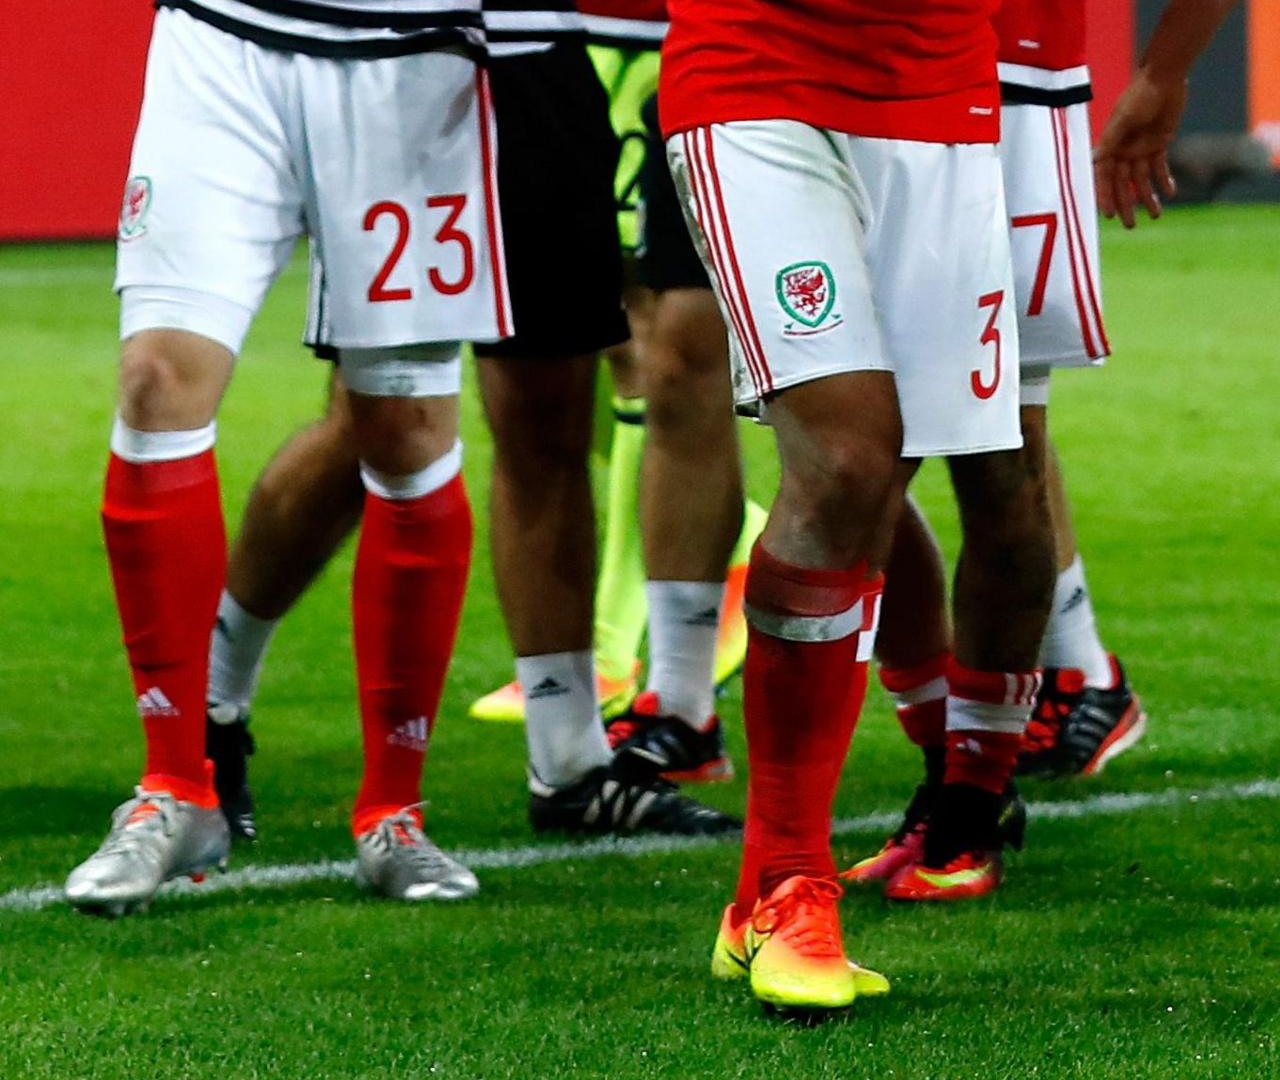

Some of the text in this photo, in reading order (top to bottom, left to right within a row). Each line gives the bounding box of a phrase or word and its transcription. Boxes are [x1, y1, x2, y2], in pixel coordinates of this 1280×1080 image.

[362, 193, 475, 303] 23
[1011, 212, 1058, 317] 7
[970, 289, 1004, 400] 3
